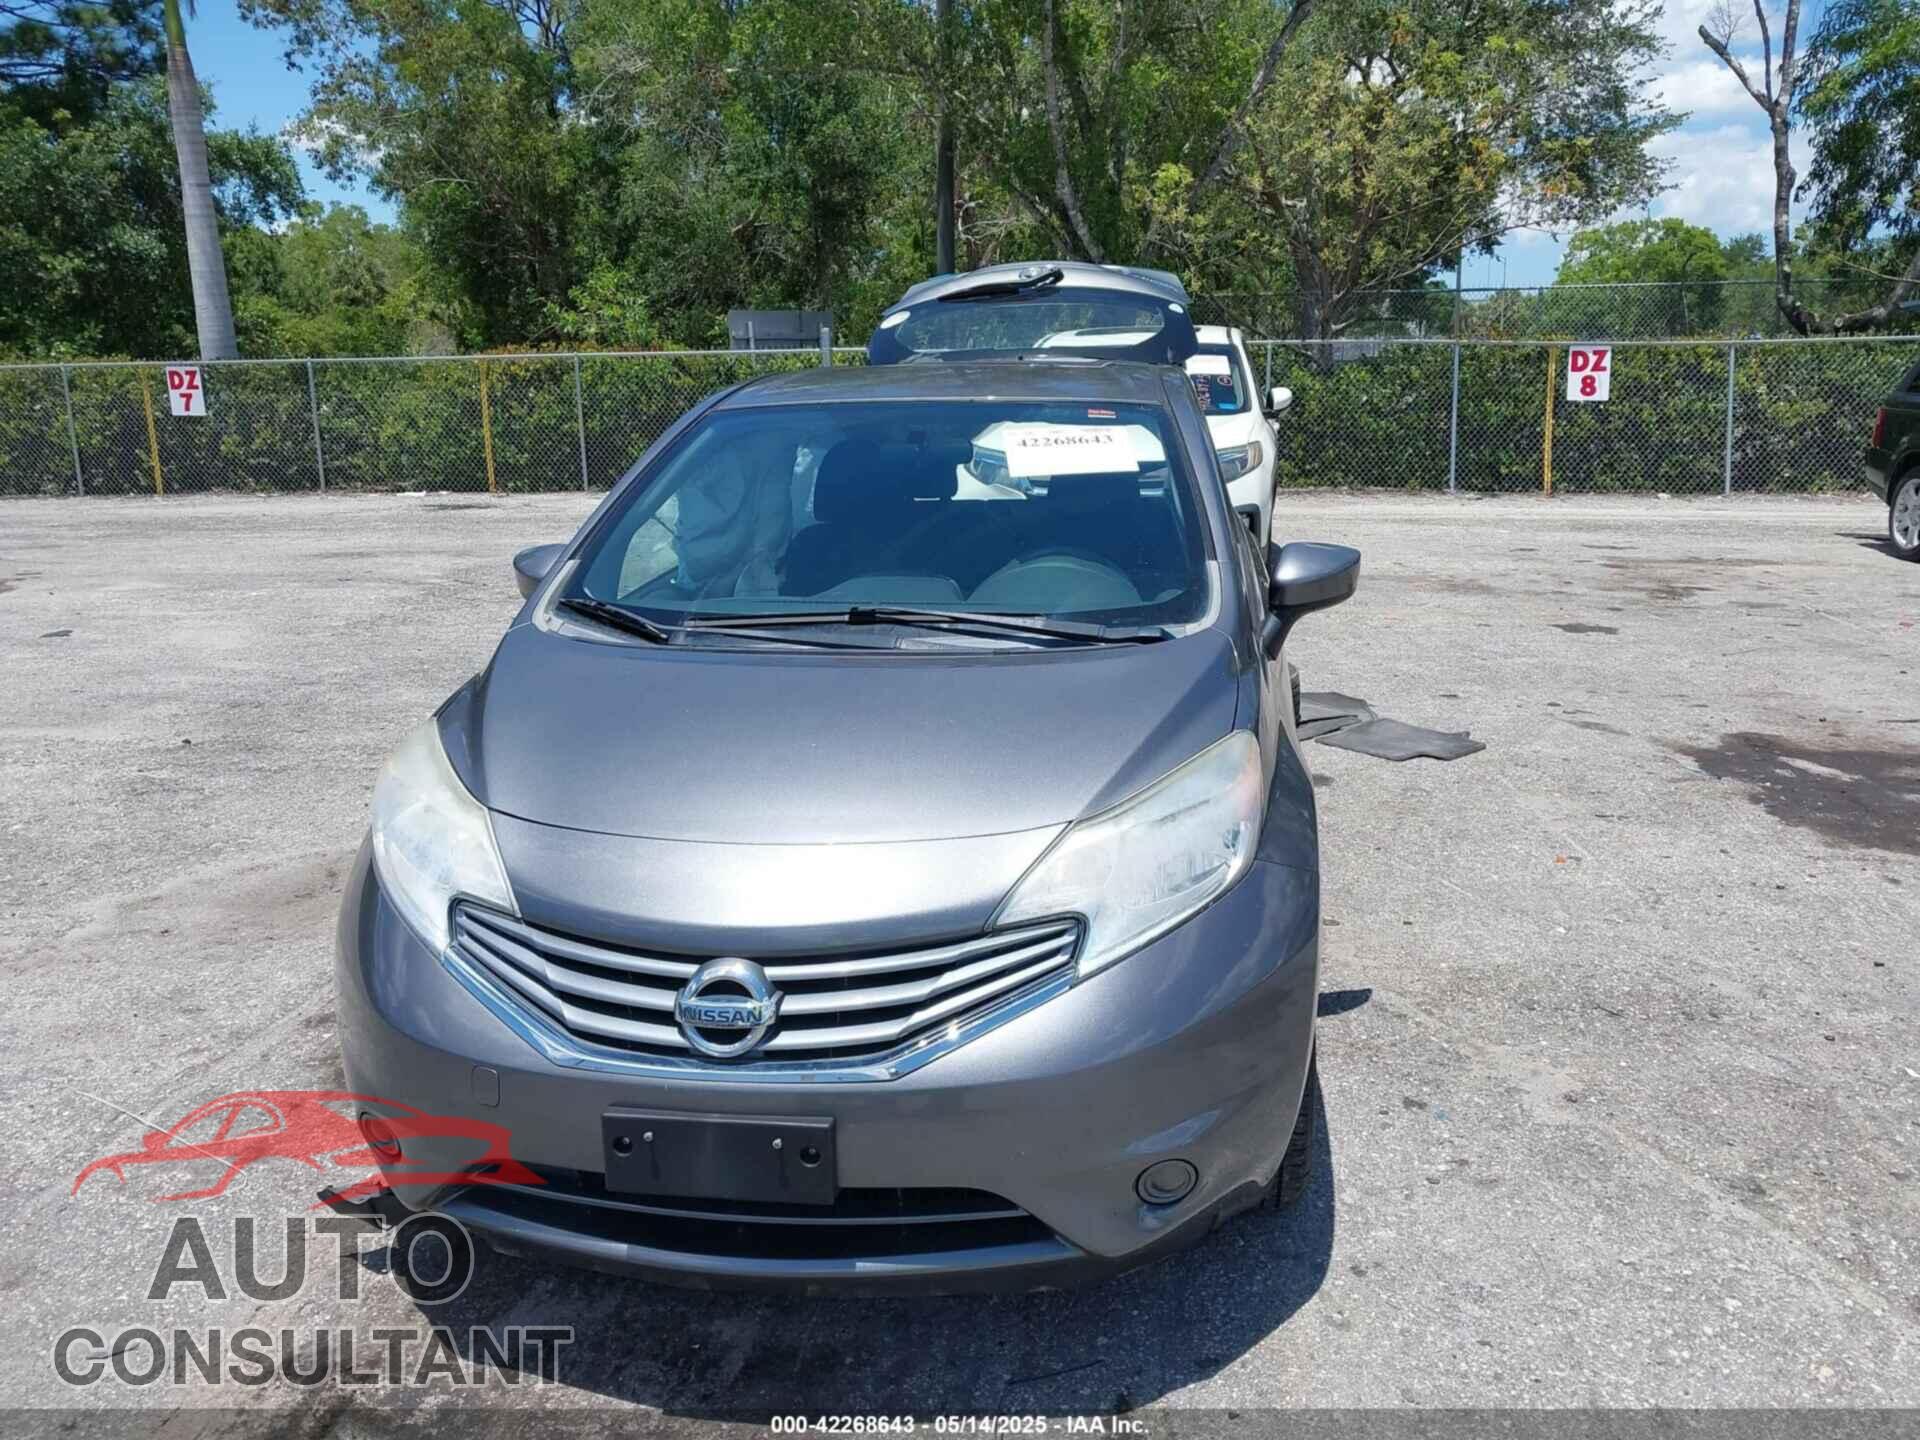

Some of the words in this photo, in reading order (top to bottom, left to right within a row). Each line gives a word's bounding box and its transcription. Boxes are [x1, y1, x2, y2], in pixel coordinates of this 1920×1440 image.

[1570, 350, 1608, 372] DZ
[168, 370, 199, 390] DZ
[1580, 375, 1597, 397] 8
[179, 393, 192, 411] 7
[1017, 434, 1113, 448] 42268643
[683, 1006, 762, 1024] NISSAN
